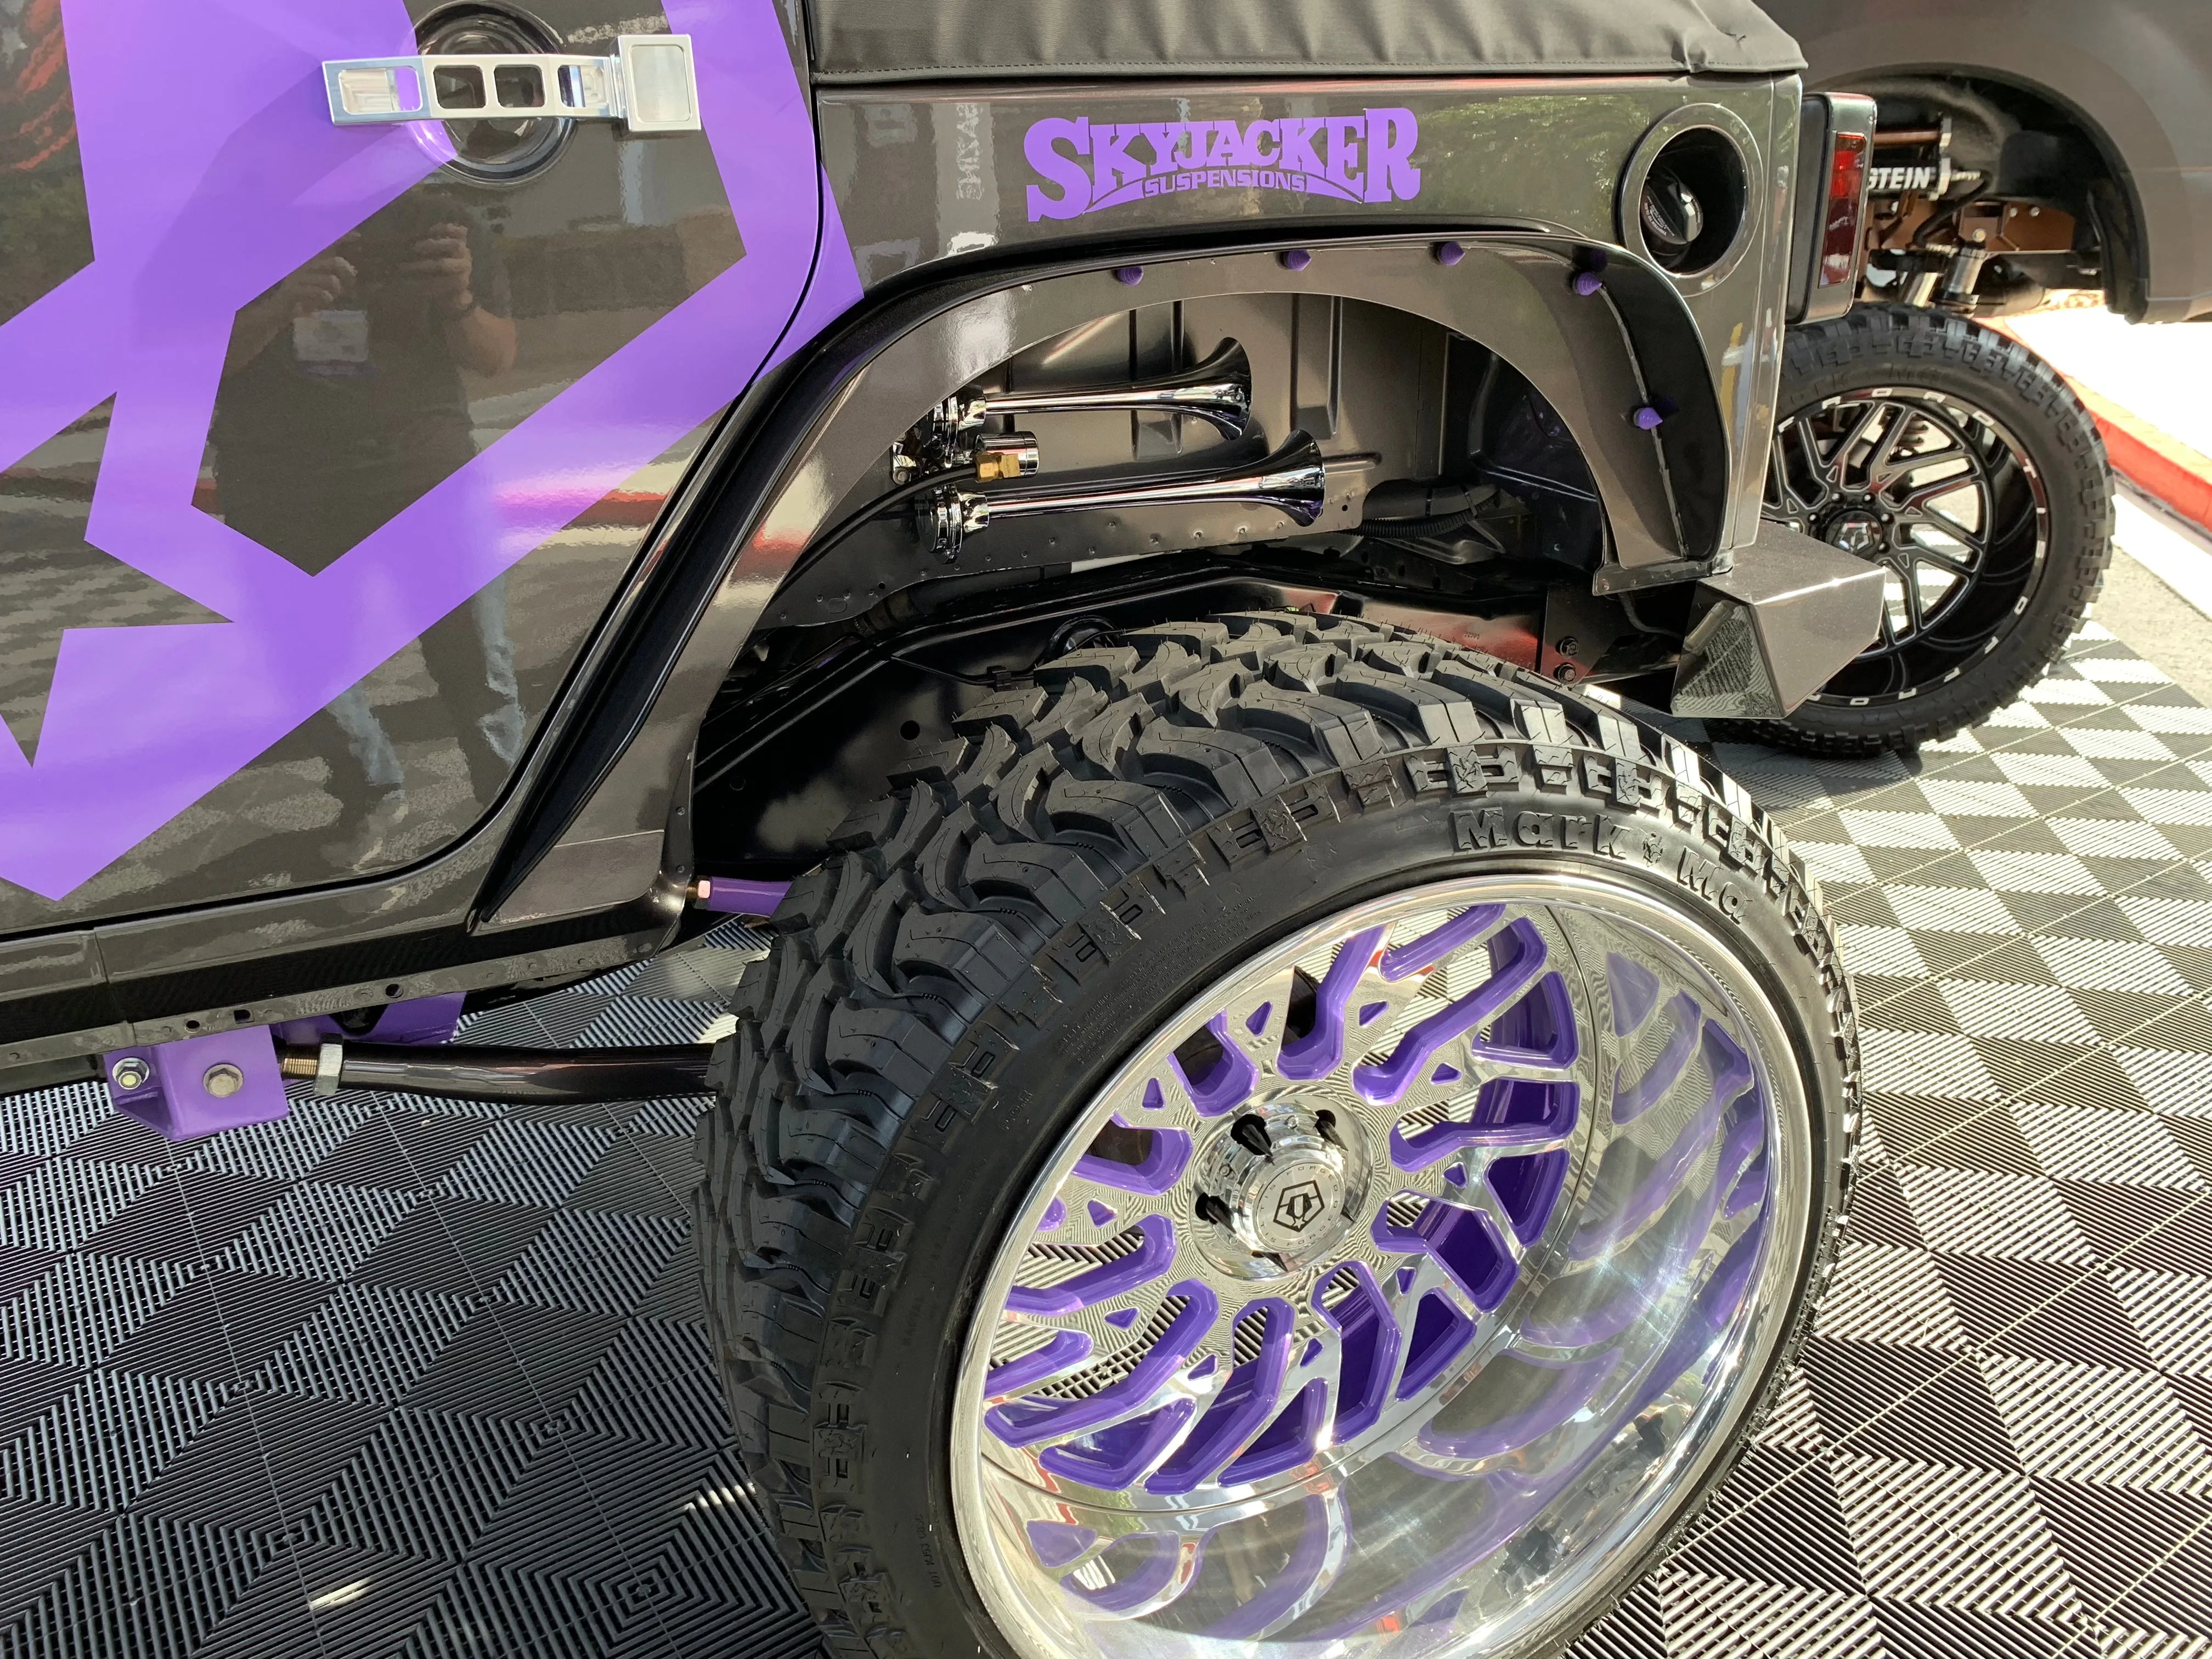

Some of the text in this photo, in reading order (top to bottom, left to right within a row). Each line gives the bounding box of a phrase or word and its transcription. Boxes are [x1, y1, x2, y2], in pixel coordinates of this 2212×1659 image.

[1024, 108, 1420, 221] SKYJACKER
[1144, 170, 1305, 198] SUSPENSIONS
[1867, 167, 1931, 190] STEIN
[1449, 806, 1632, 860] Mark
[1261, 1165, 1338, 1211] TIS FORGED
[1261, 1200, 1338, 1247] TIS FORGED
